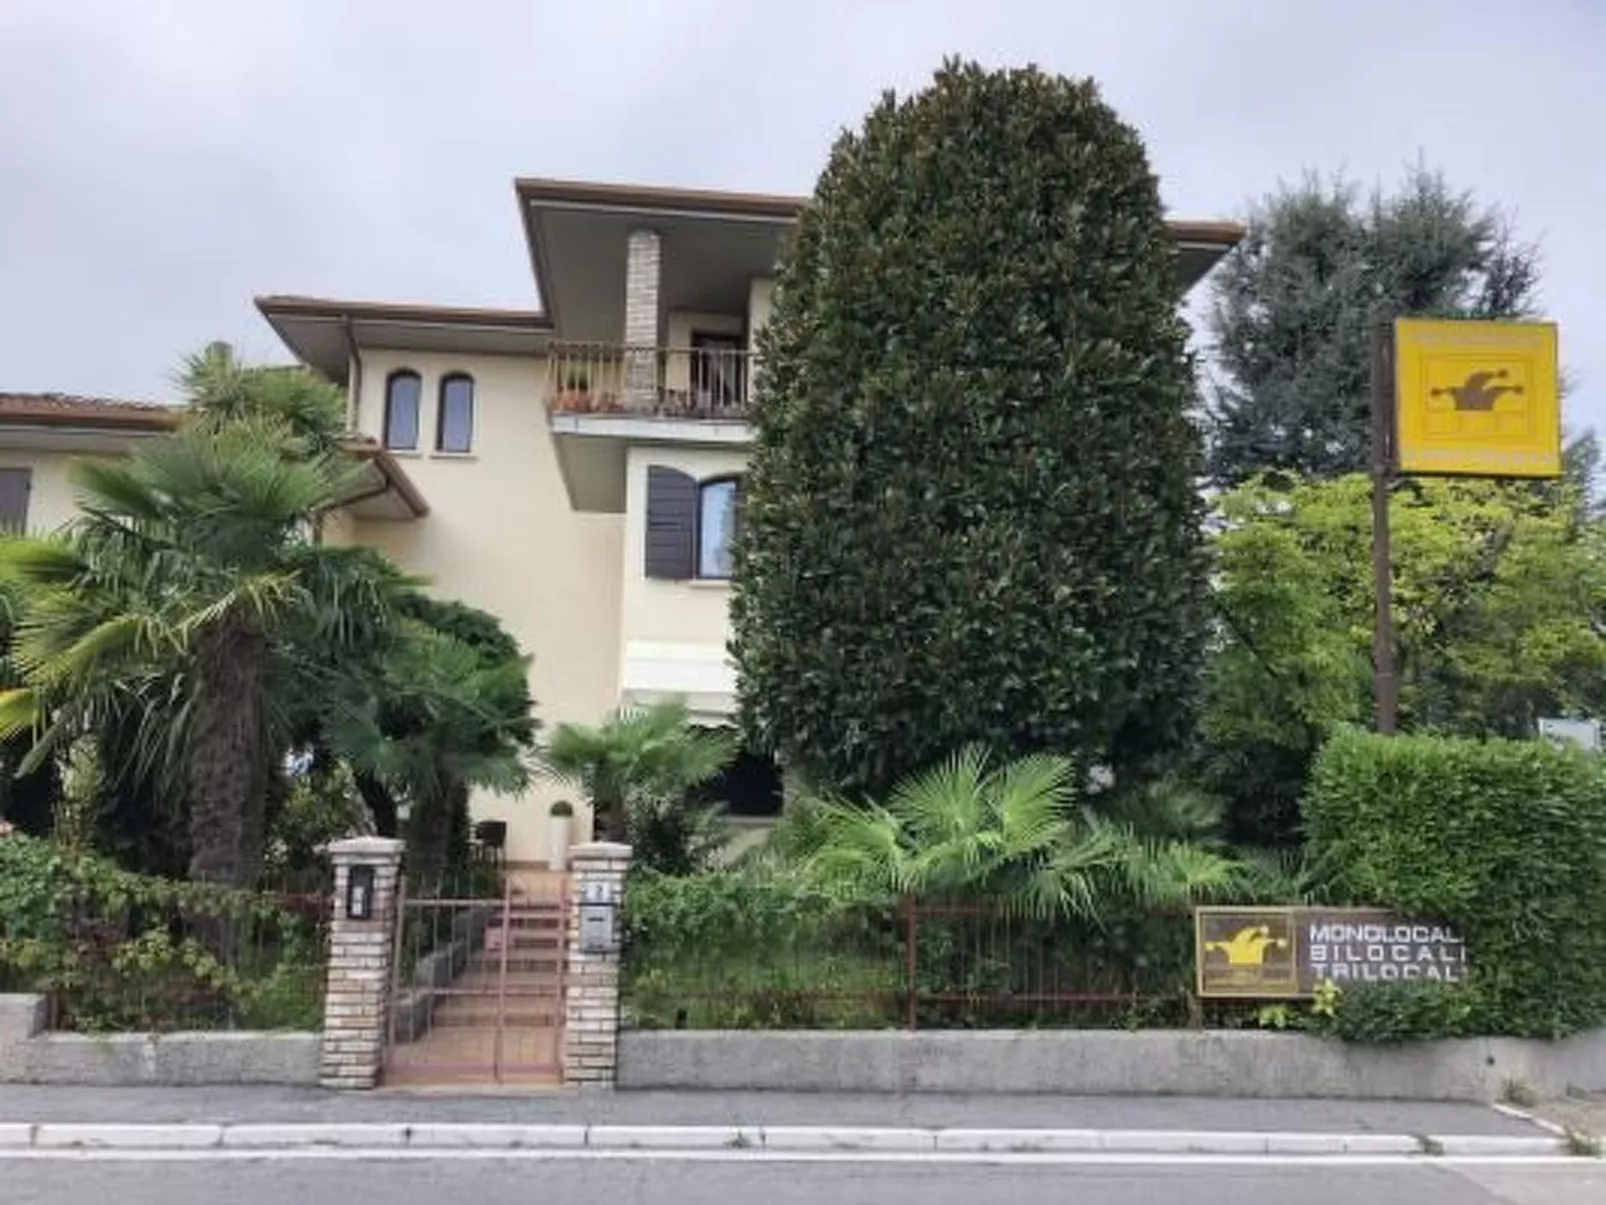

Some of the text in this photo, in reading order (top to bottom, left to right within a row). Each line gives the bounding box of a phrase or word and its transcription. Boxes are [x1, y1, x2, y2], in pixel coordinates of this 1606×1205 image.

[1310, 924, 1464, 942] MONOLOCAL
[1310, 945, 1465, 962] BILOCALI
[1310, 963, 1463, 981] TRILOCAL
